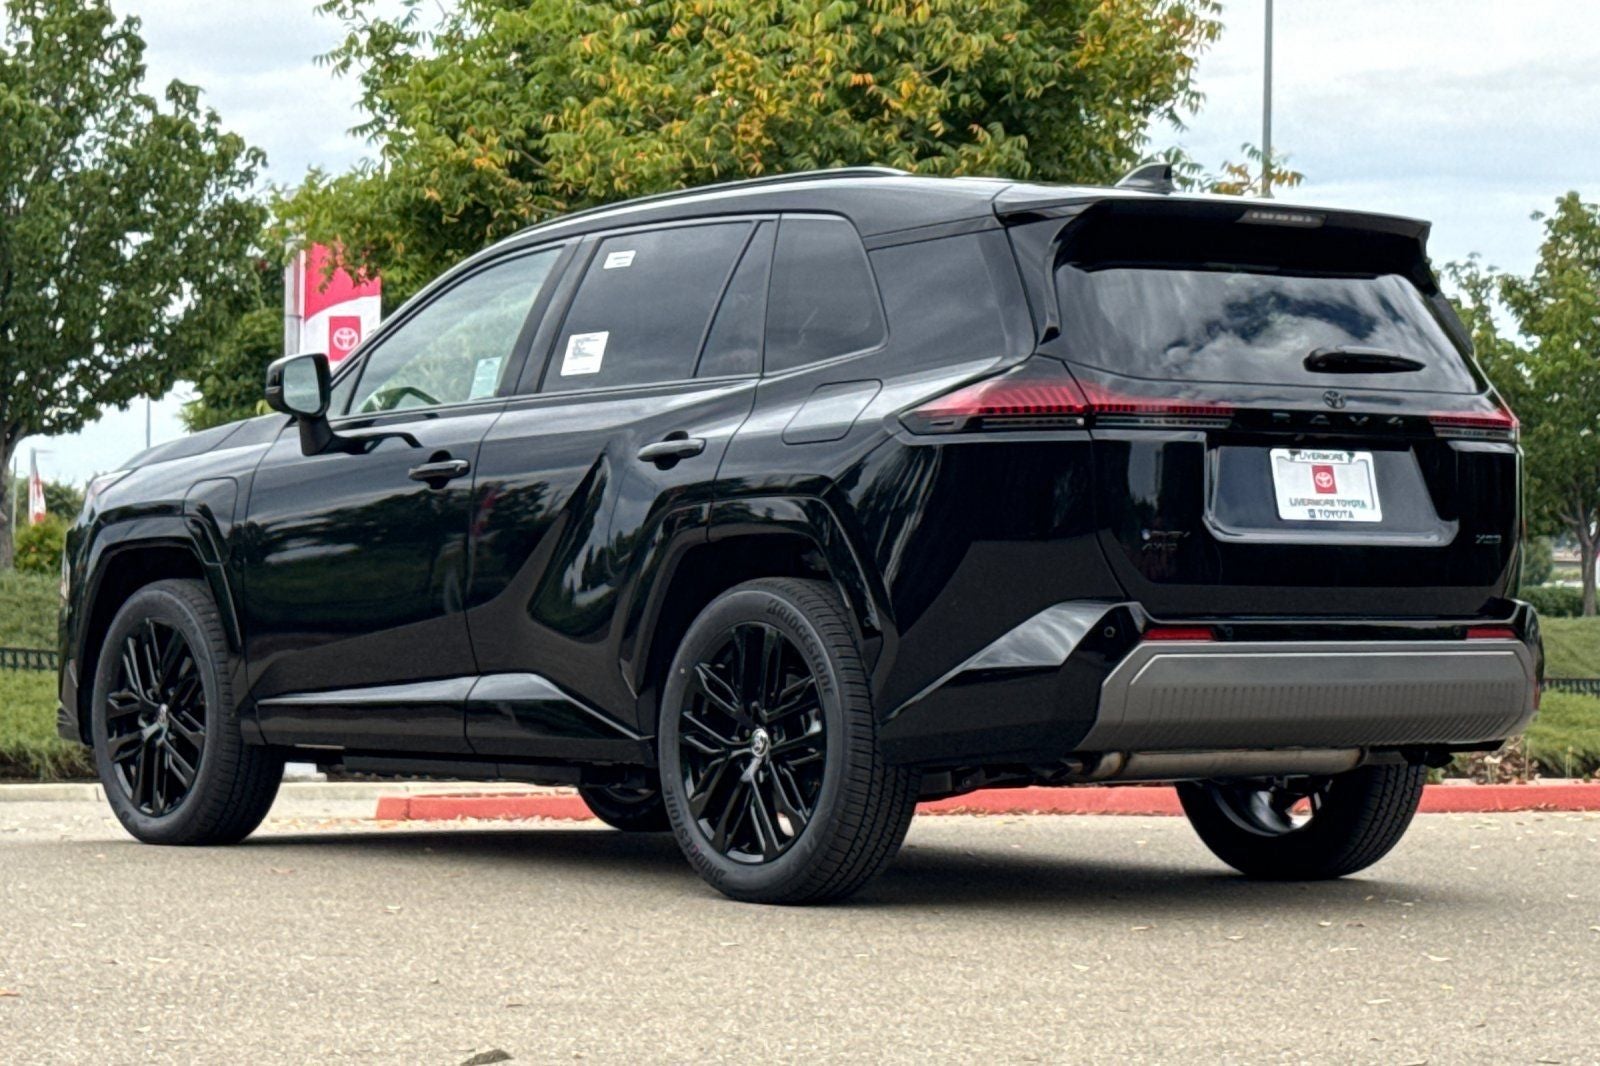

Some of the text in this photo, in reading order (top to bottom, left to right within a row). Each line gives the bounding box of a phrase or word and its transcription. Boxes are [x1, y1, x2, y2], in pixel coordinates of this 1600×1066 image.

[1271, 411, 1405, 427] RAV4
[1300, 451, 1344, 461] LIVERMORE
[1289, 497, 1367, 508] LIVERMORE TOYOTA
[1318, 509, 1354, 519] TOYOTA
[766, 599, 834, 696] BRIDGESTONE
[665, 785, 727, 884] BRIDGESTONE
